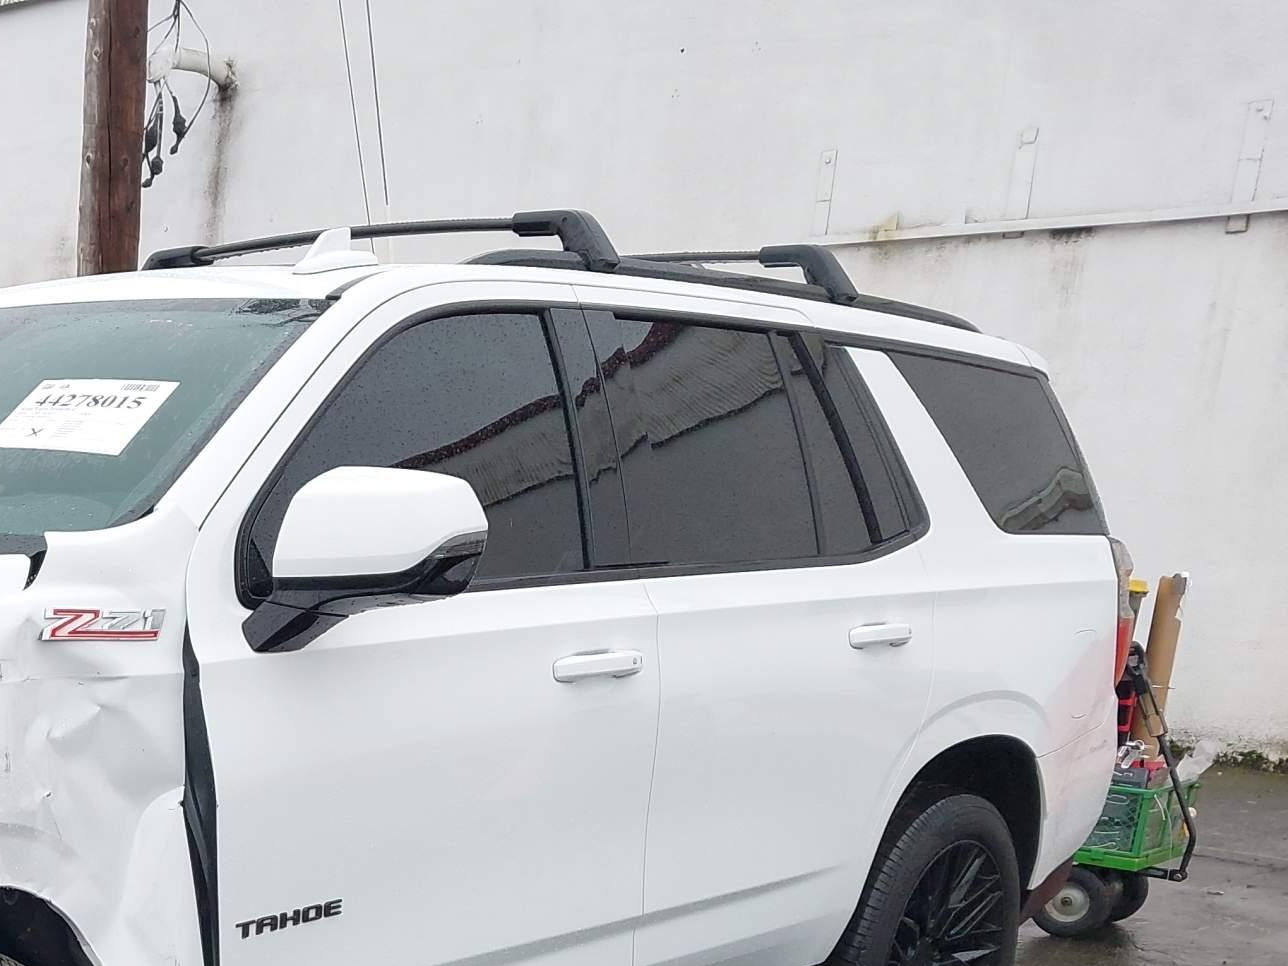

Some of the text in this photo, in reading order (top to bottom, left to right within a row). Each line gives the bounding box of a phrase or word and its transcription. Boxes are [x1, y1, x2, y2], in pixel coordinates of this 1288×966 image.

[34, 393, 148, 409] 44278015
[39, 608, 167, 641] Z71
[235, 898, 343, 940] TAHOE
